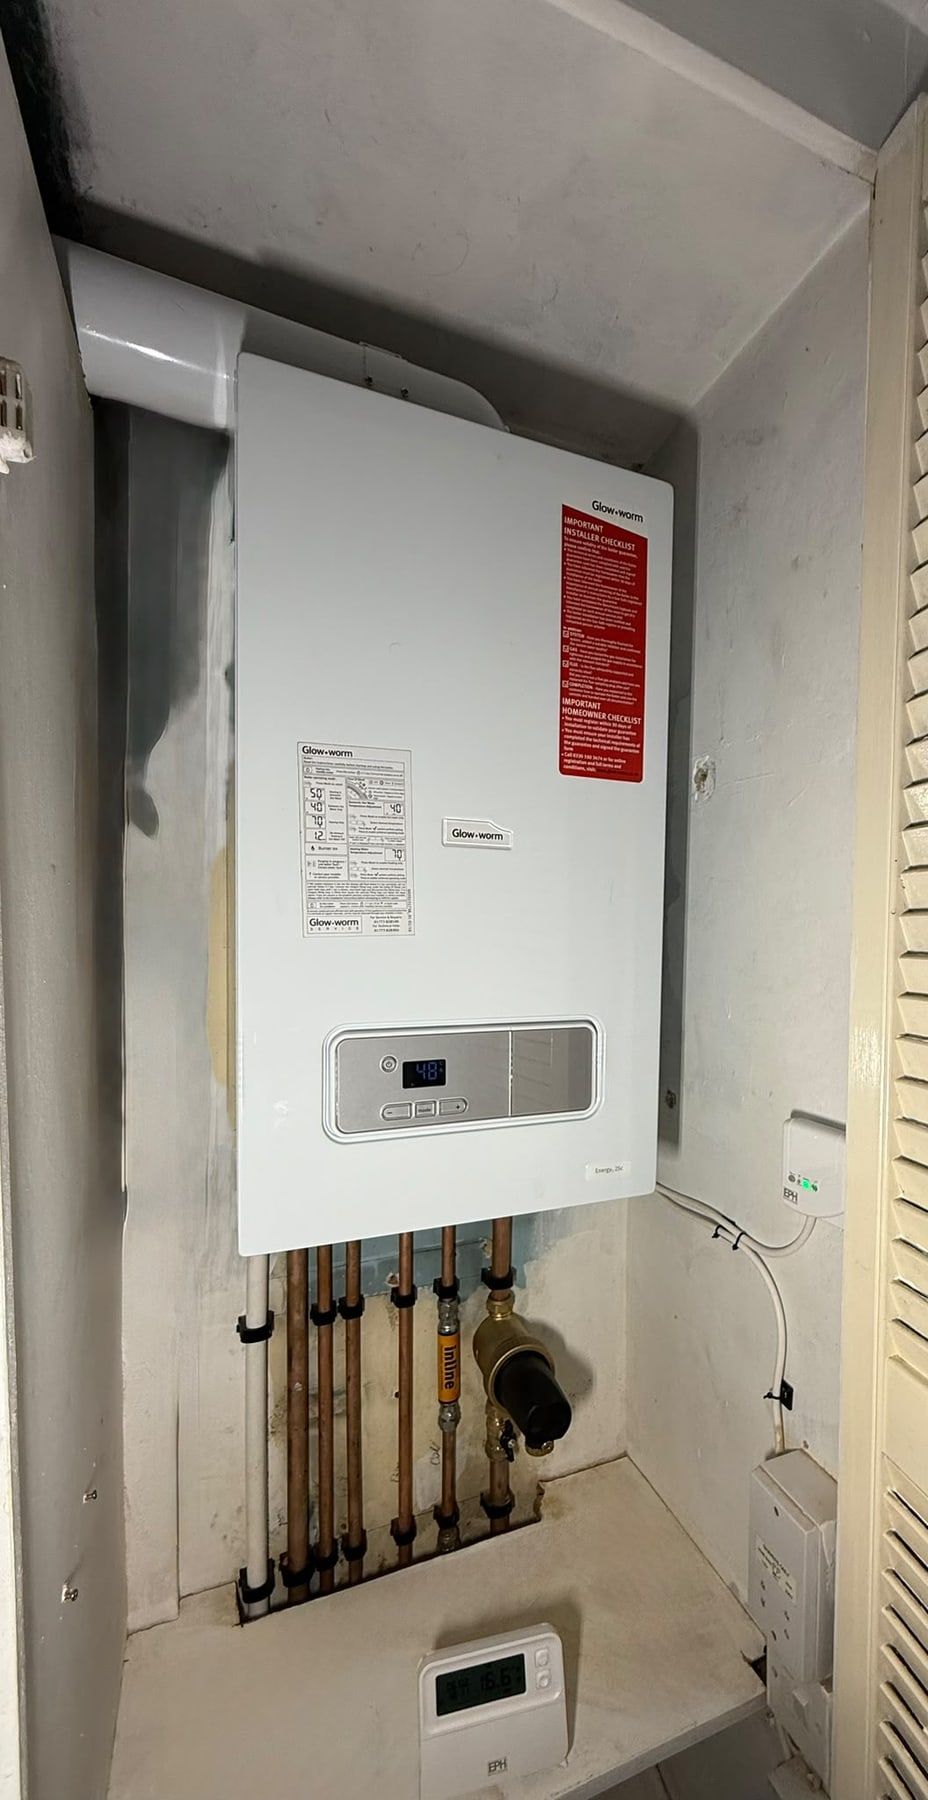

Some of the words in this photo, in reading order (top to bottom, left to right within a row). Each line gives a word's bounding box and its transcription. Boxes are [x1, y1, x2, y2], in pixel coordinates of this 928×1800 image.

[564, 516, 603, 533] IMPORTANT
[564, 527, 600, 542] INSTALLER
[600, 536, 635, 551] CHECKLIST
[562, 697, 601, 710] IMPORTANT
[562, 707, 606, 720] HOMEOWNER
[607, 713, 641, 724] CHECKLIST
[416, 1062, 437, 1080] 48
[783, 1187, 798, 1204] EPH
[488, 1757, 507, 1772] EPH
